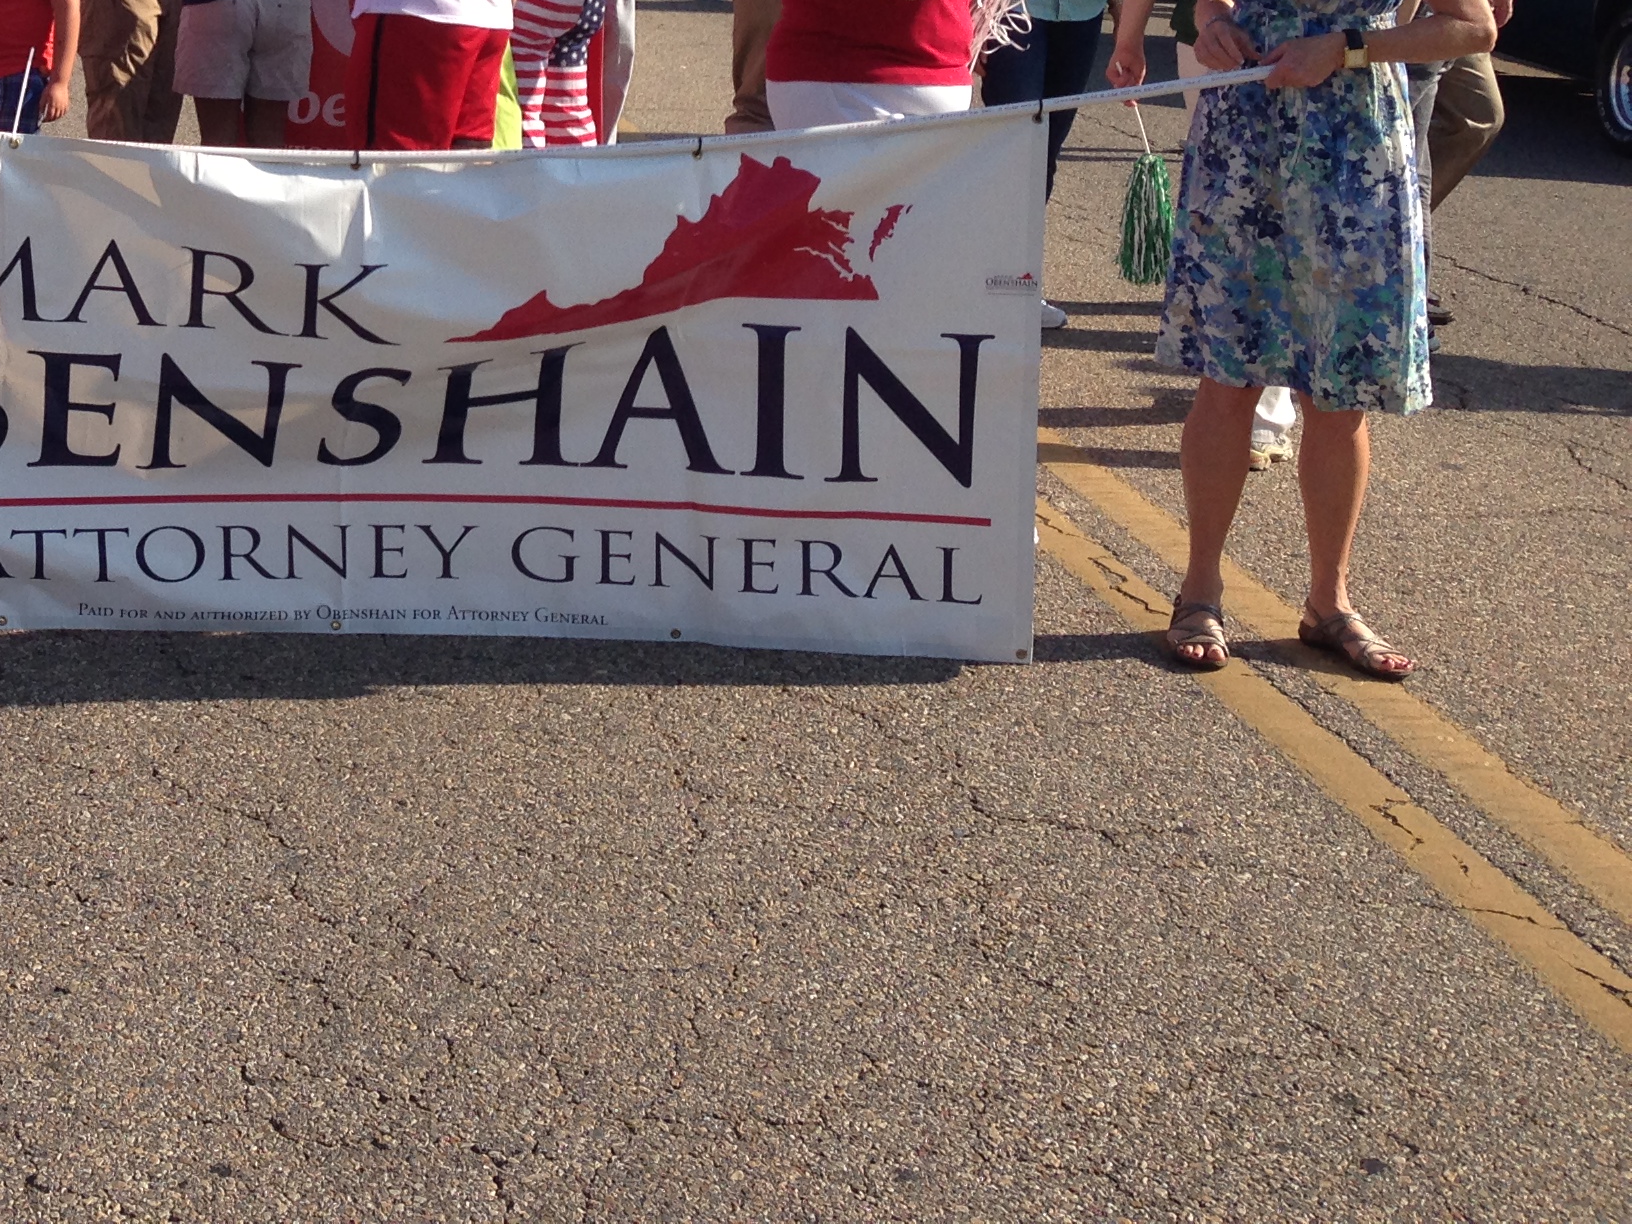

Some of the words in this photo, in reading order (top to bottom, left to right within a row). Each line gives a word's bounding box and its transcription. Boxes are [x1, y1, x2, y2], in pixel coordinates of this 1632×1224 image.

[510, 525, 984, 606] GENERAL
[78, 603, 114, 618] PAID
[119, 609, 149, 619] FOR
[153, 610, 187, 620] AND
[190, 610, 289, 622] AUTHORIZED
[293, 610, 312, 622] BY
[316, 604, 407, 621] OBENSHAIN
[412, 609, 442, 621] FOR
[446, 605, 530, 623] ATTORNEY
[534, 607, 609, 626] GENERAL
